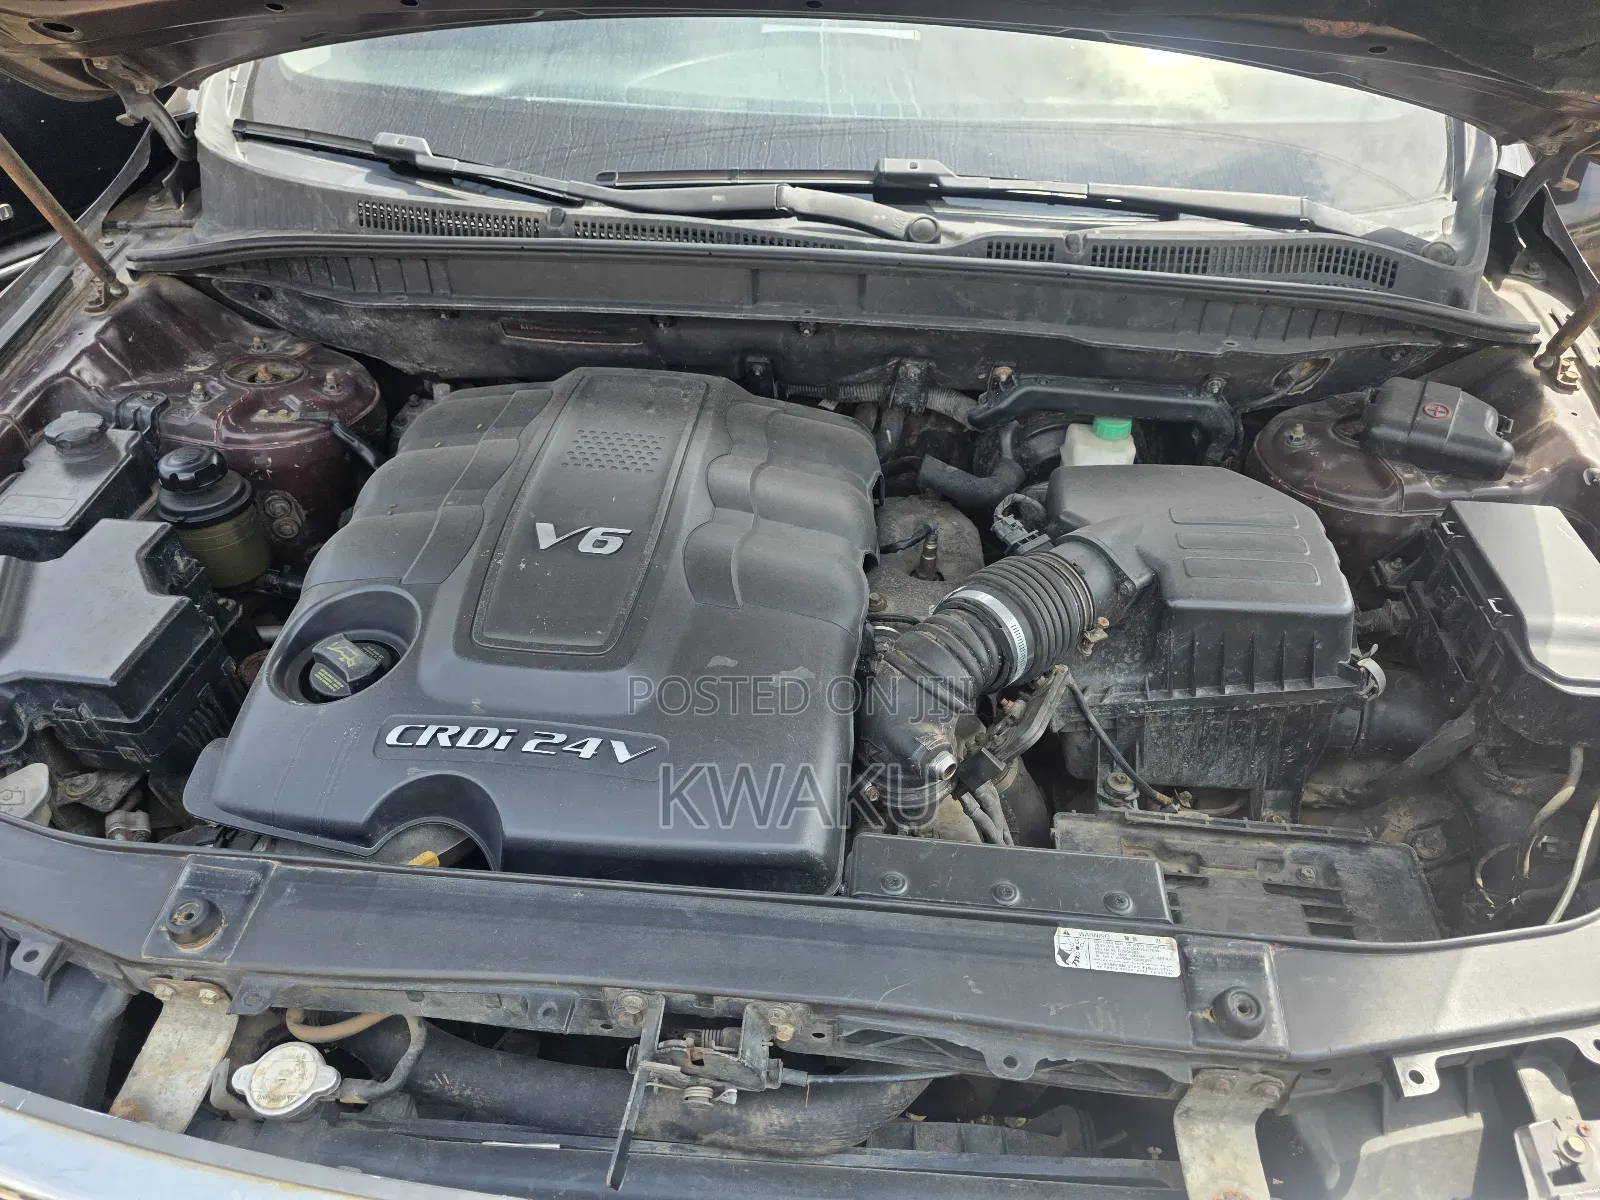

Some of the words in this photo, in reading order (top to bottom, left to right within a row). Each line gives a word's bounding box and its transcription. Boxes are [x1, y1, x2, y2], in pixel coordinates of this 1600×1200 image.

[535, 522, 633, 555] V6
[385, 724, 518, 750] CRDi
[521, 730, 657, 764] 24V
